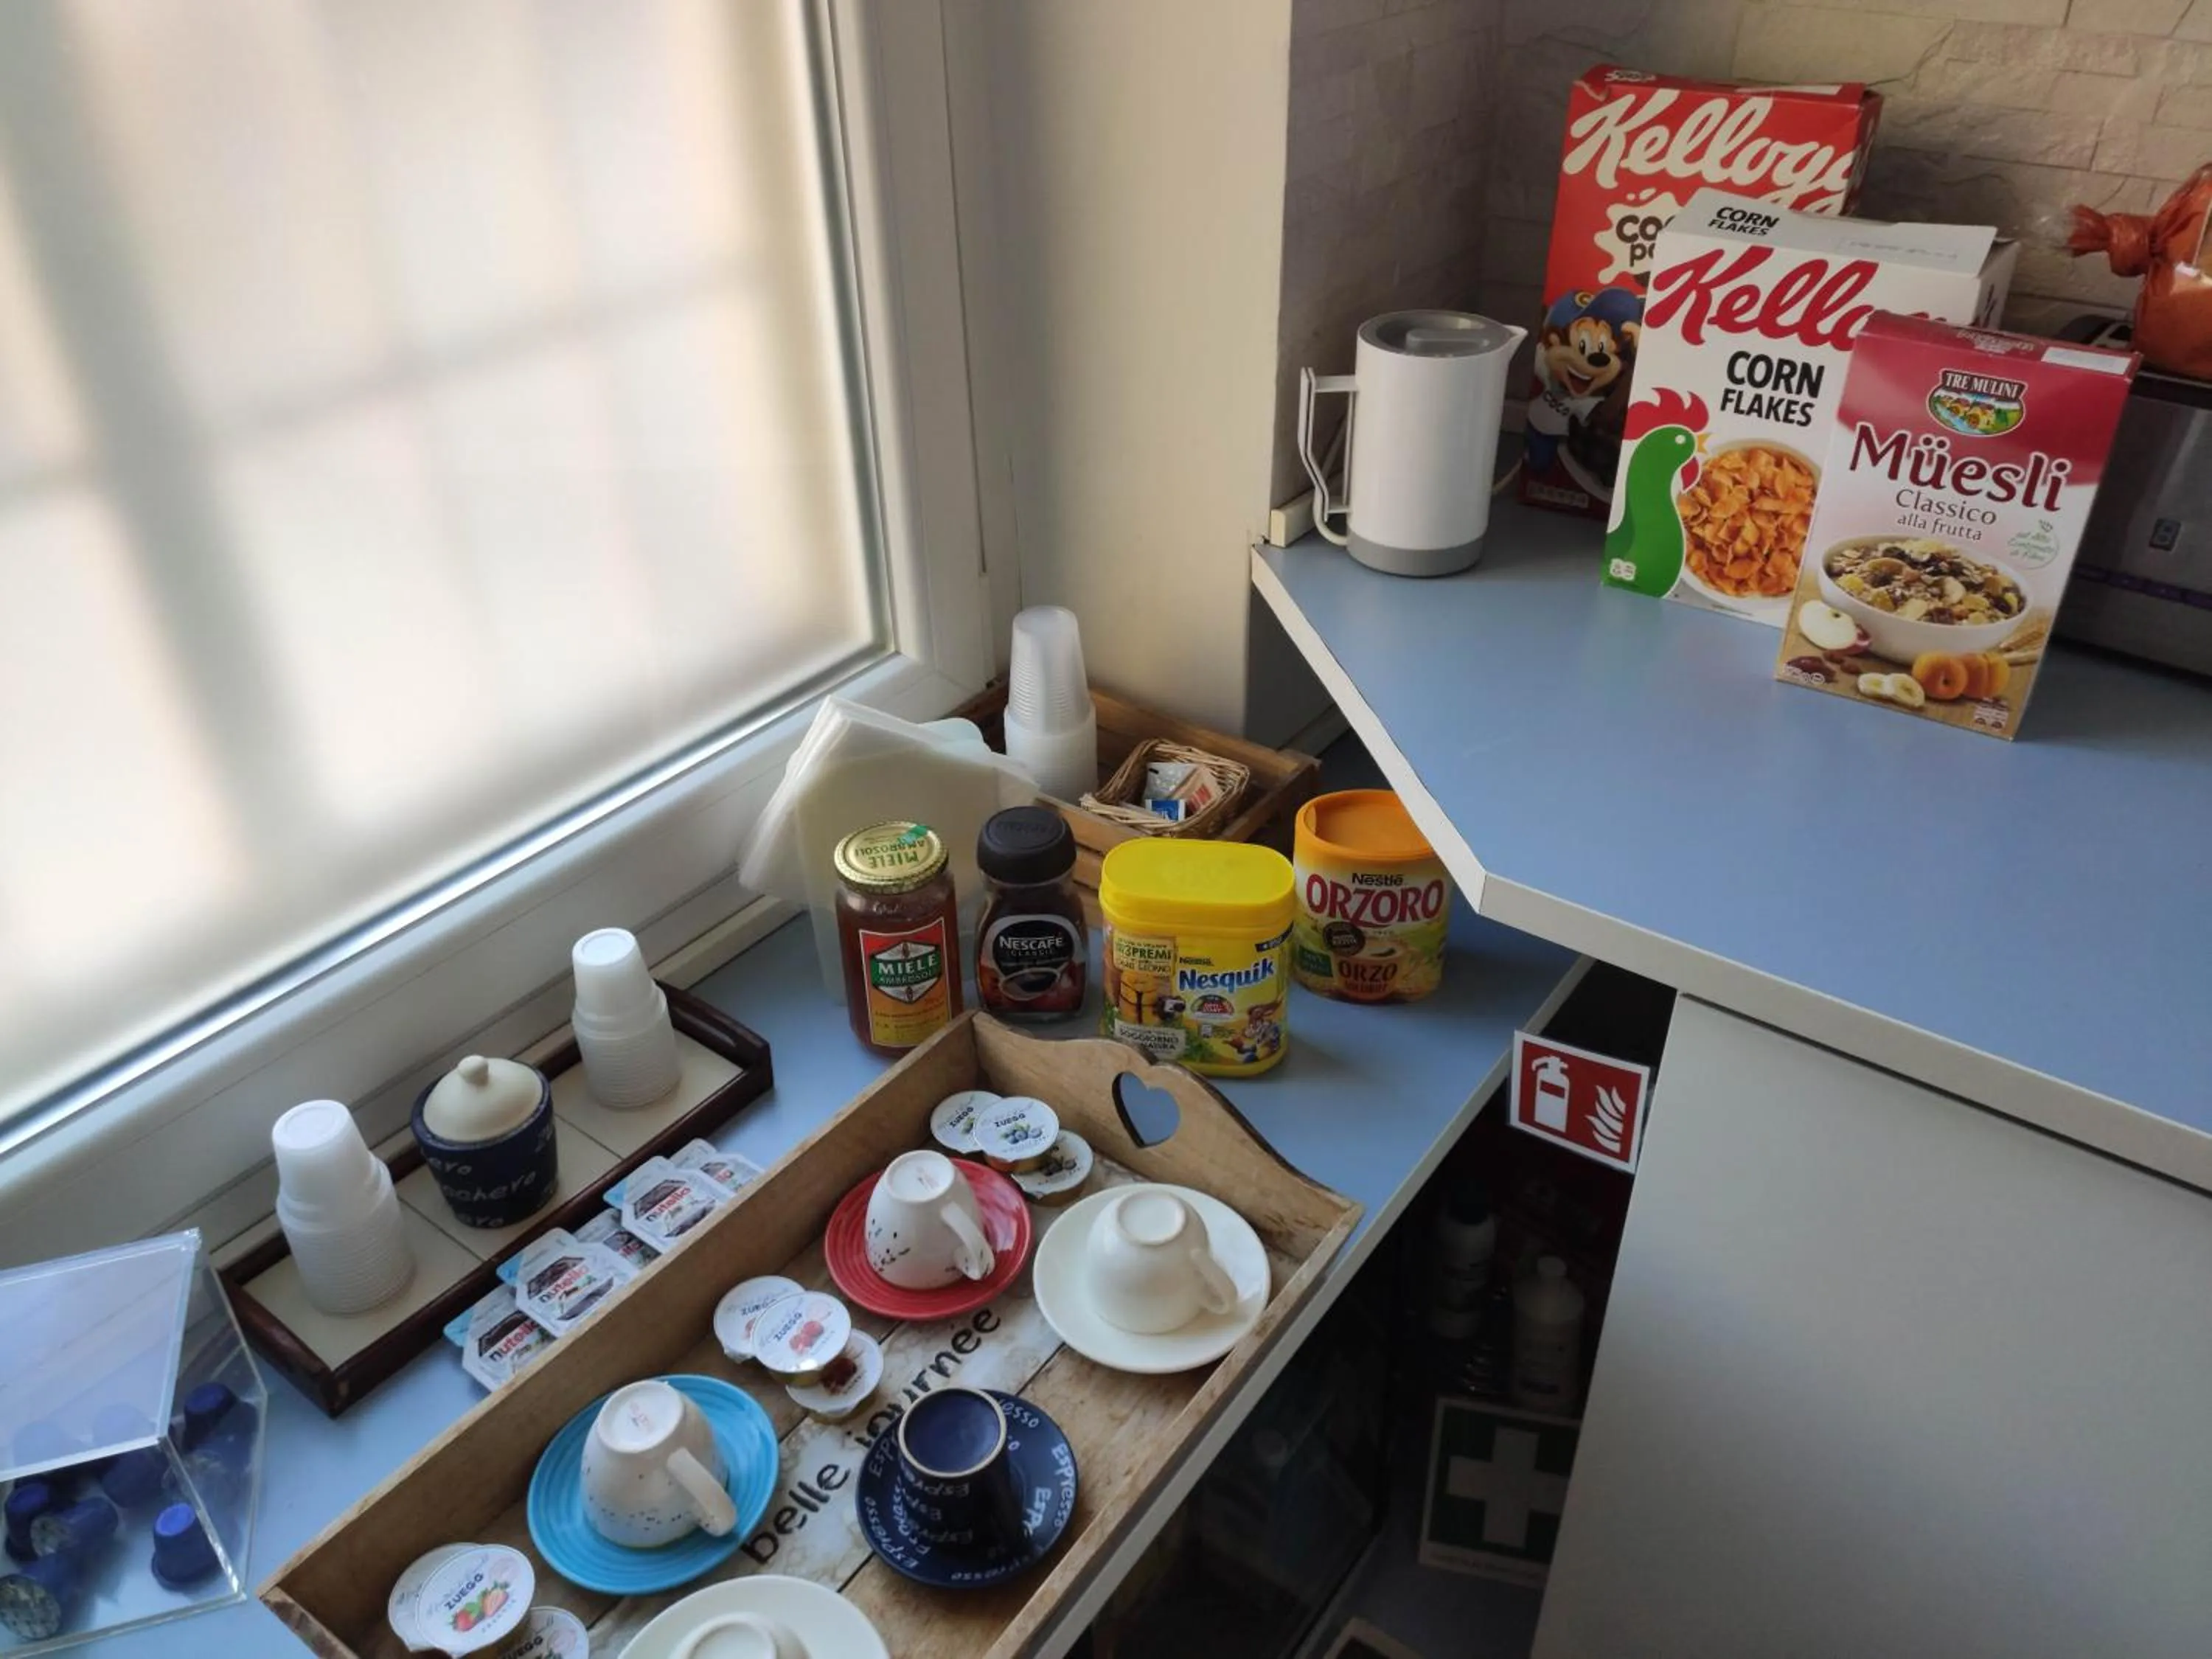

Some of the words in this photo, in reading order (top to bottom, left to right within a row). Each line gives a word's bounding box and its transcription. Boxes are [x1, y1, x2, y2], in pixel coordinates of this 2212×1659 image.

[1708, 219, 1770, 237] FLAKES
[1715, 206, 1780, 229] CORN
[1727, 350, 1825, 398] CORN
[1946, 372, 1968, 390] TRE
[1972, 376, 2020, 399] MULINI
[1720, 388, 1815, 428] FLAKES
[1848, 422, 2073, 512] Müesli
[1896, 488, 1997, 526] Classico
[1897, 513, 1926, 531] alla
[1930, 519, 1983, 541] frutta
[869, 851, 919, 869] MIELE
[1306, 873, 1444, 928] ORZORO
[878, 954, 936, 975] MIELE
[1179, 958, 1274, 993] Nesquik
[1338, 960, 1398, 983] ORZO
[740, 1464, 850, 1565] belle
[445, 1572, 484, 1611] ZUEGG
